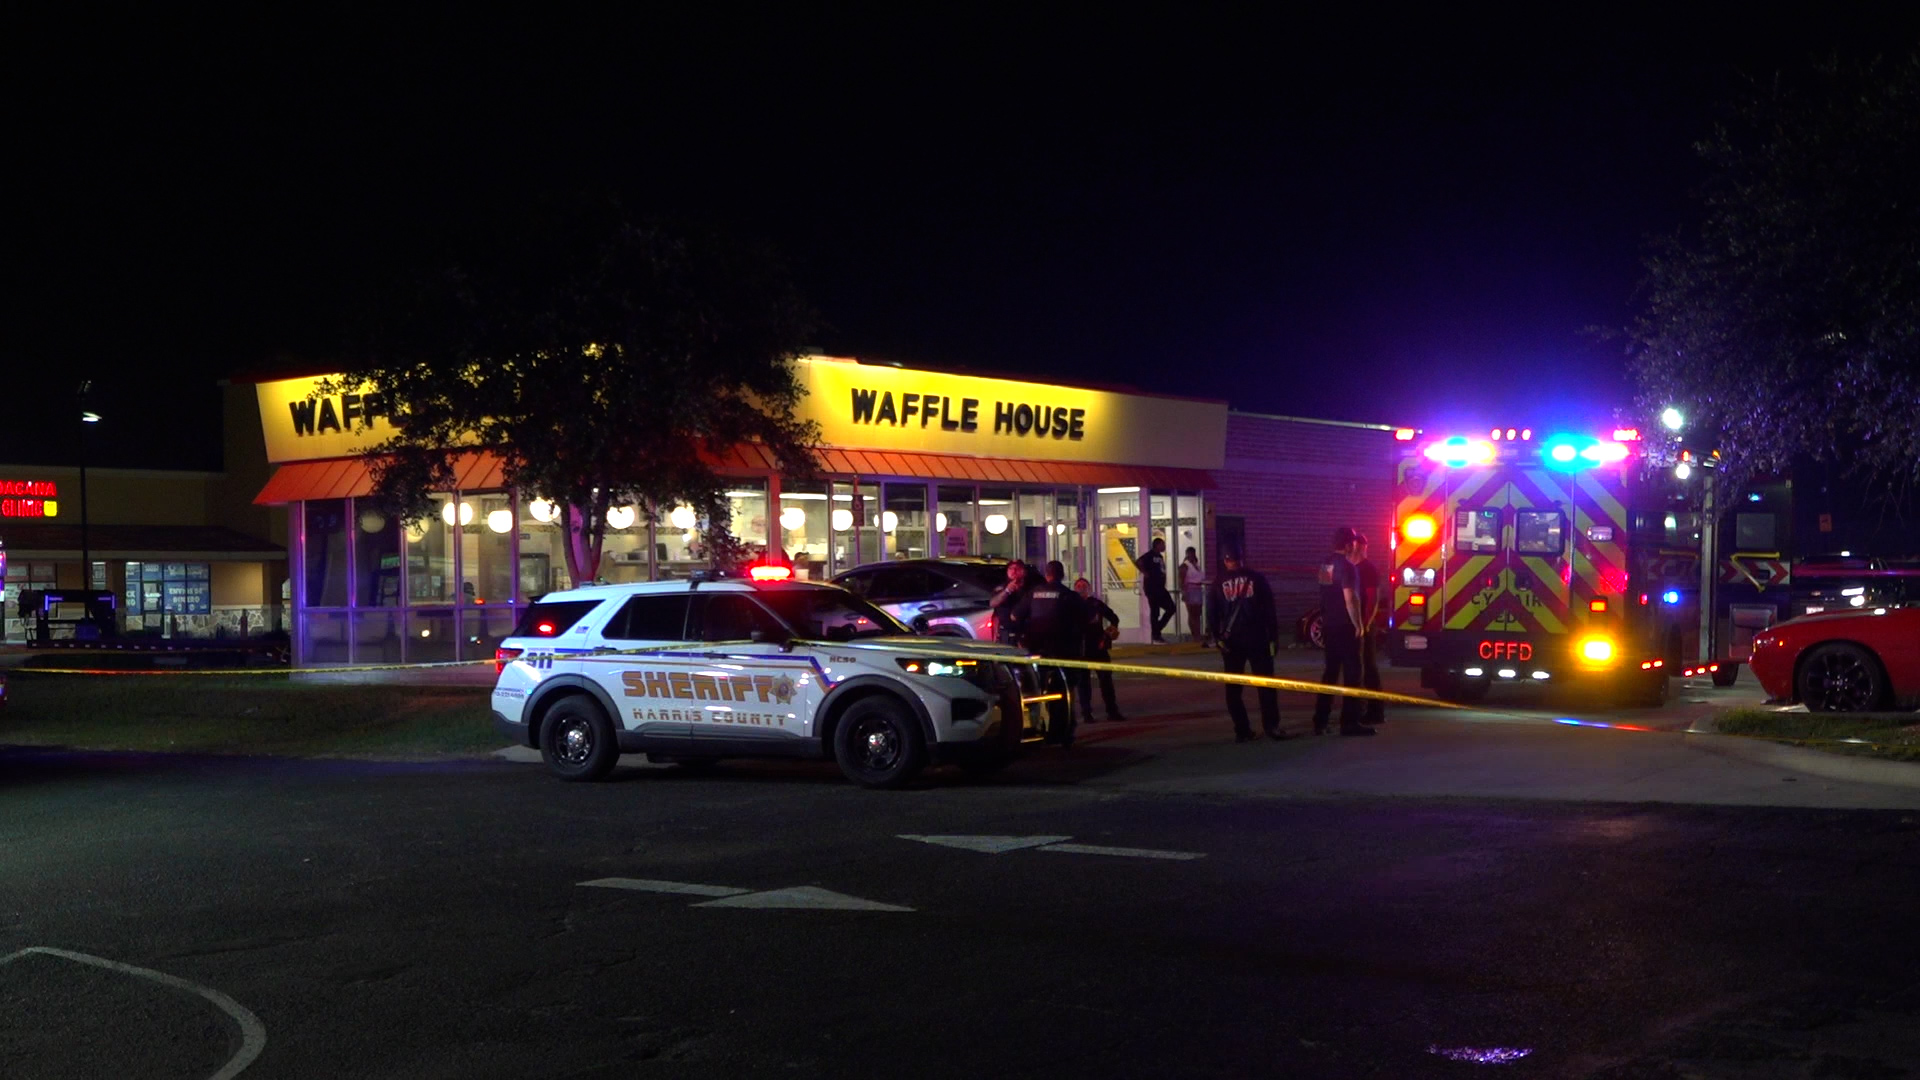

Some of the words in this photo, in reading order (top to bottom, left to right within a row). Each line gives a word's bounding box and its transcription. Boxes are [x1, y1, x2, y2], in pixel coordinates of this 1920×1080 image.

[289, 391, 409, 437] WAFF
[851, 387, 979, 433] WAFFLE
[995, 401, 1085, 441] HOUSE
[526, 652, 553, 669] 911
[1479, 641, 1533, 661] CFFD
[621, 670, 774, 703] SHERIFF
[632, 708, 703, 722] HARRIS
[711, 710, 785, 726] COUNTY
